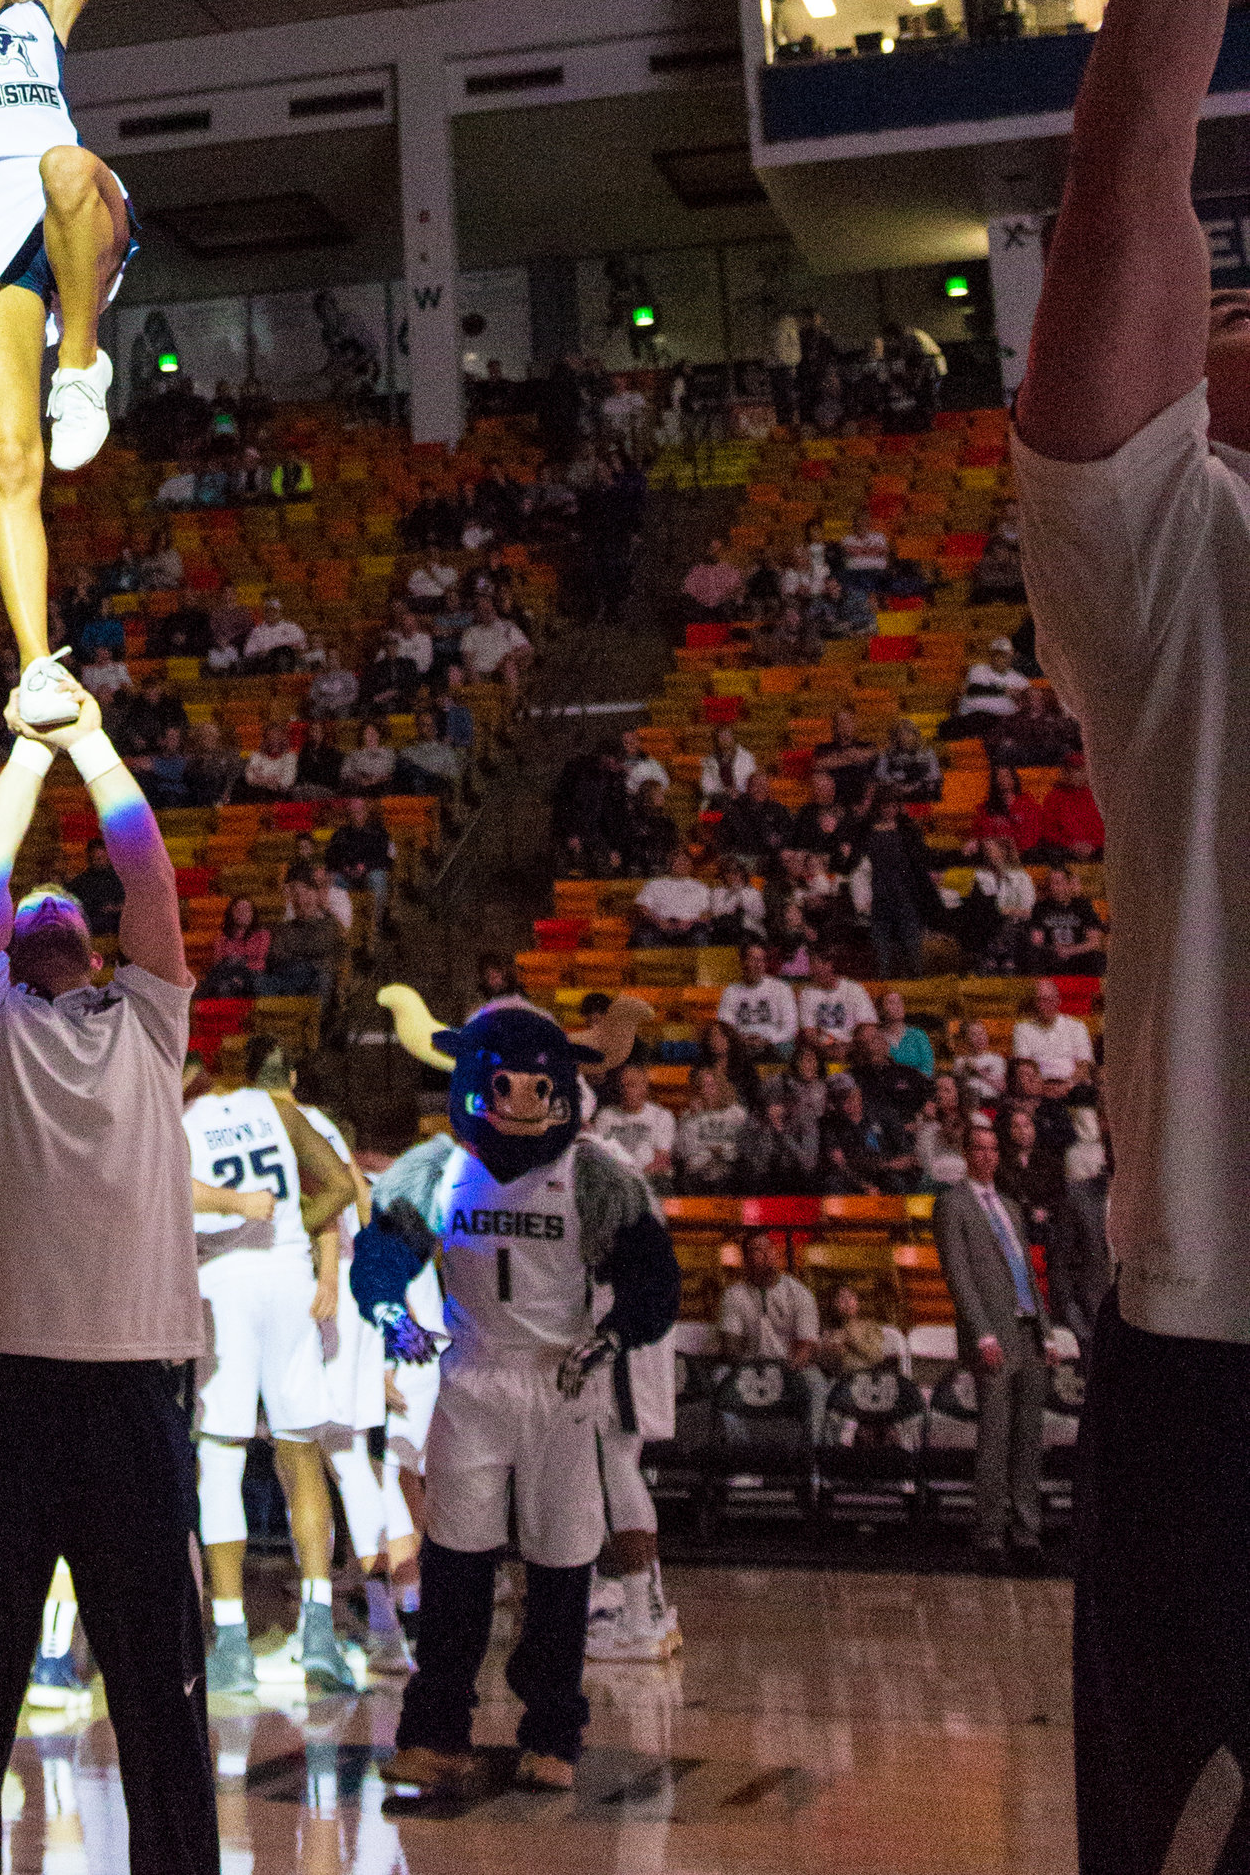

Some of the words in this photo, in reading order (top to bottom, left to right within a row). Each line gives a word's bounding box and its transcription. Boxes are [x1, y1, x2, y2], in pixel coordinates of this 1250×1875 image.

[3, 81, 61, 109] STATE
[211, 1144, 289, 1201] 25
[451, 1208, 565, 1241] AGGIES
[496, 1247, 512, 1303] 1
